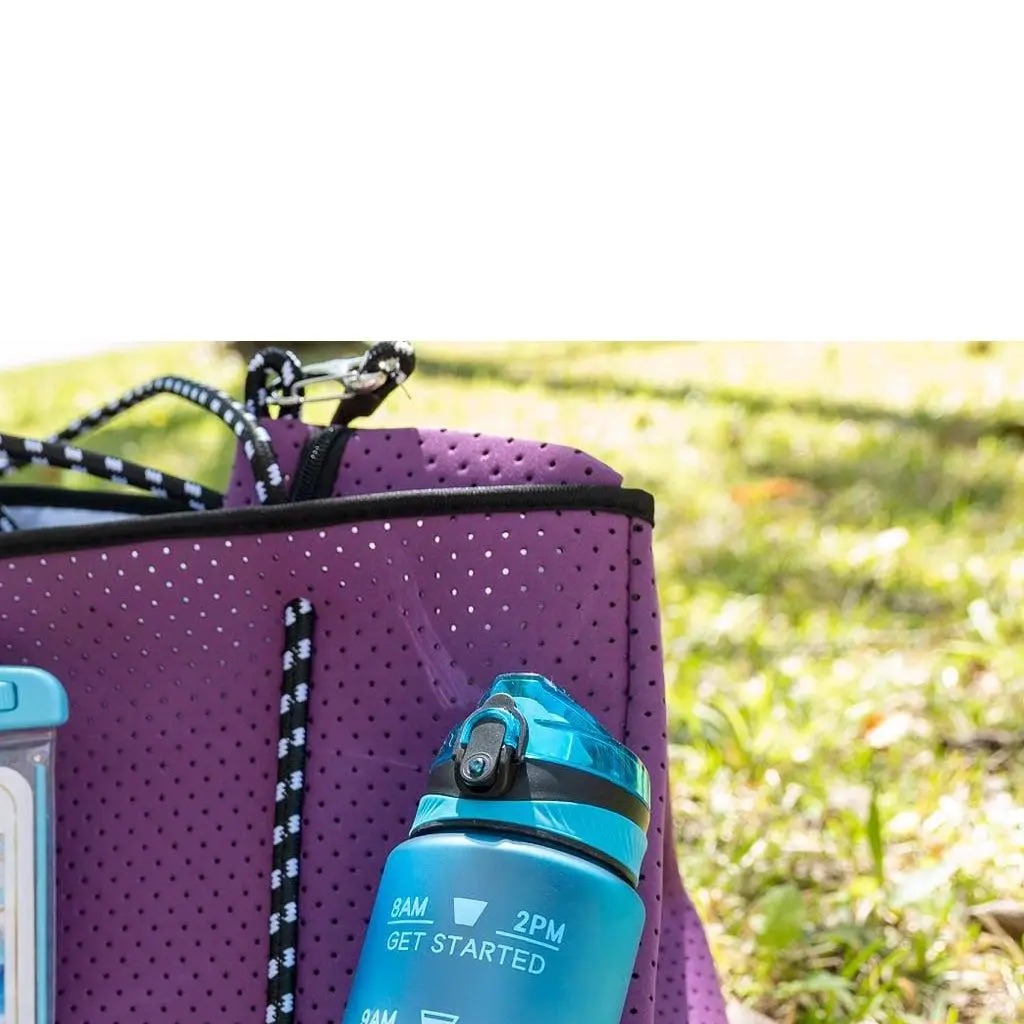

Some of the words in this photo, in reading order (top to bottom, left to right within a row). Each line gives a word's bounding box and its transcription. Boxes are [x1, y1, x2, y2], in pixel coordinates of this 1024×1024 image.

[391, 897, 429, 918] 8AM
[513, 911, 565, 944] 2PM
[387, 931, 426, 951] GET
[431, 933, 545, 975] STARTED
